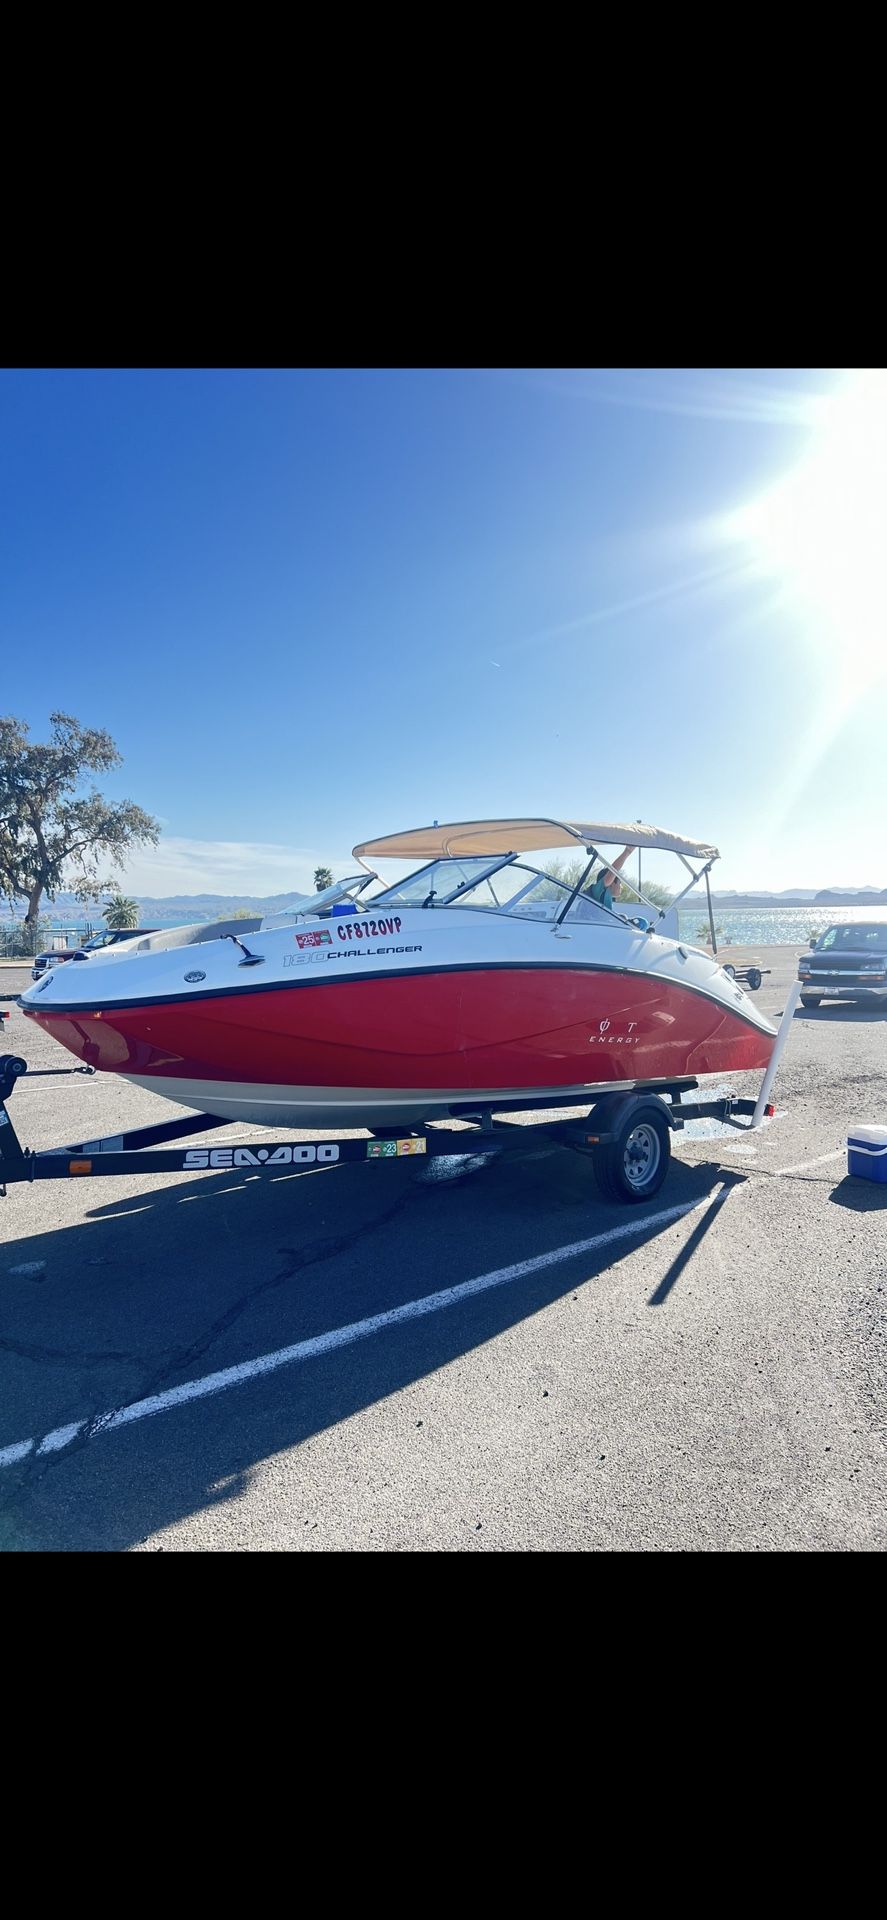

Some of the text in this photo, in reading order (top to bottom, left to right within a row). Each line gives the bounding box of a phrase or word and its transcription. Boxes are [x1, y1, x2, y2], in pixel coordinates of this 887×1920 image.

[337, 916, 402, 941] CF8720VP
[301, 935, 315, 945] 25
[283, 945, 422, 967] 180 CHALLENGER
[589, 1036, 641, 1044] ENERGY
[386, 1143, 397, 1153] 23
